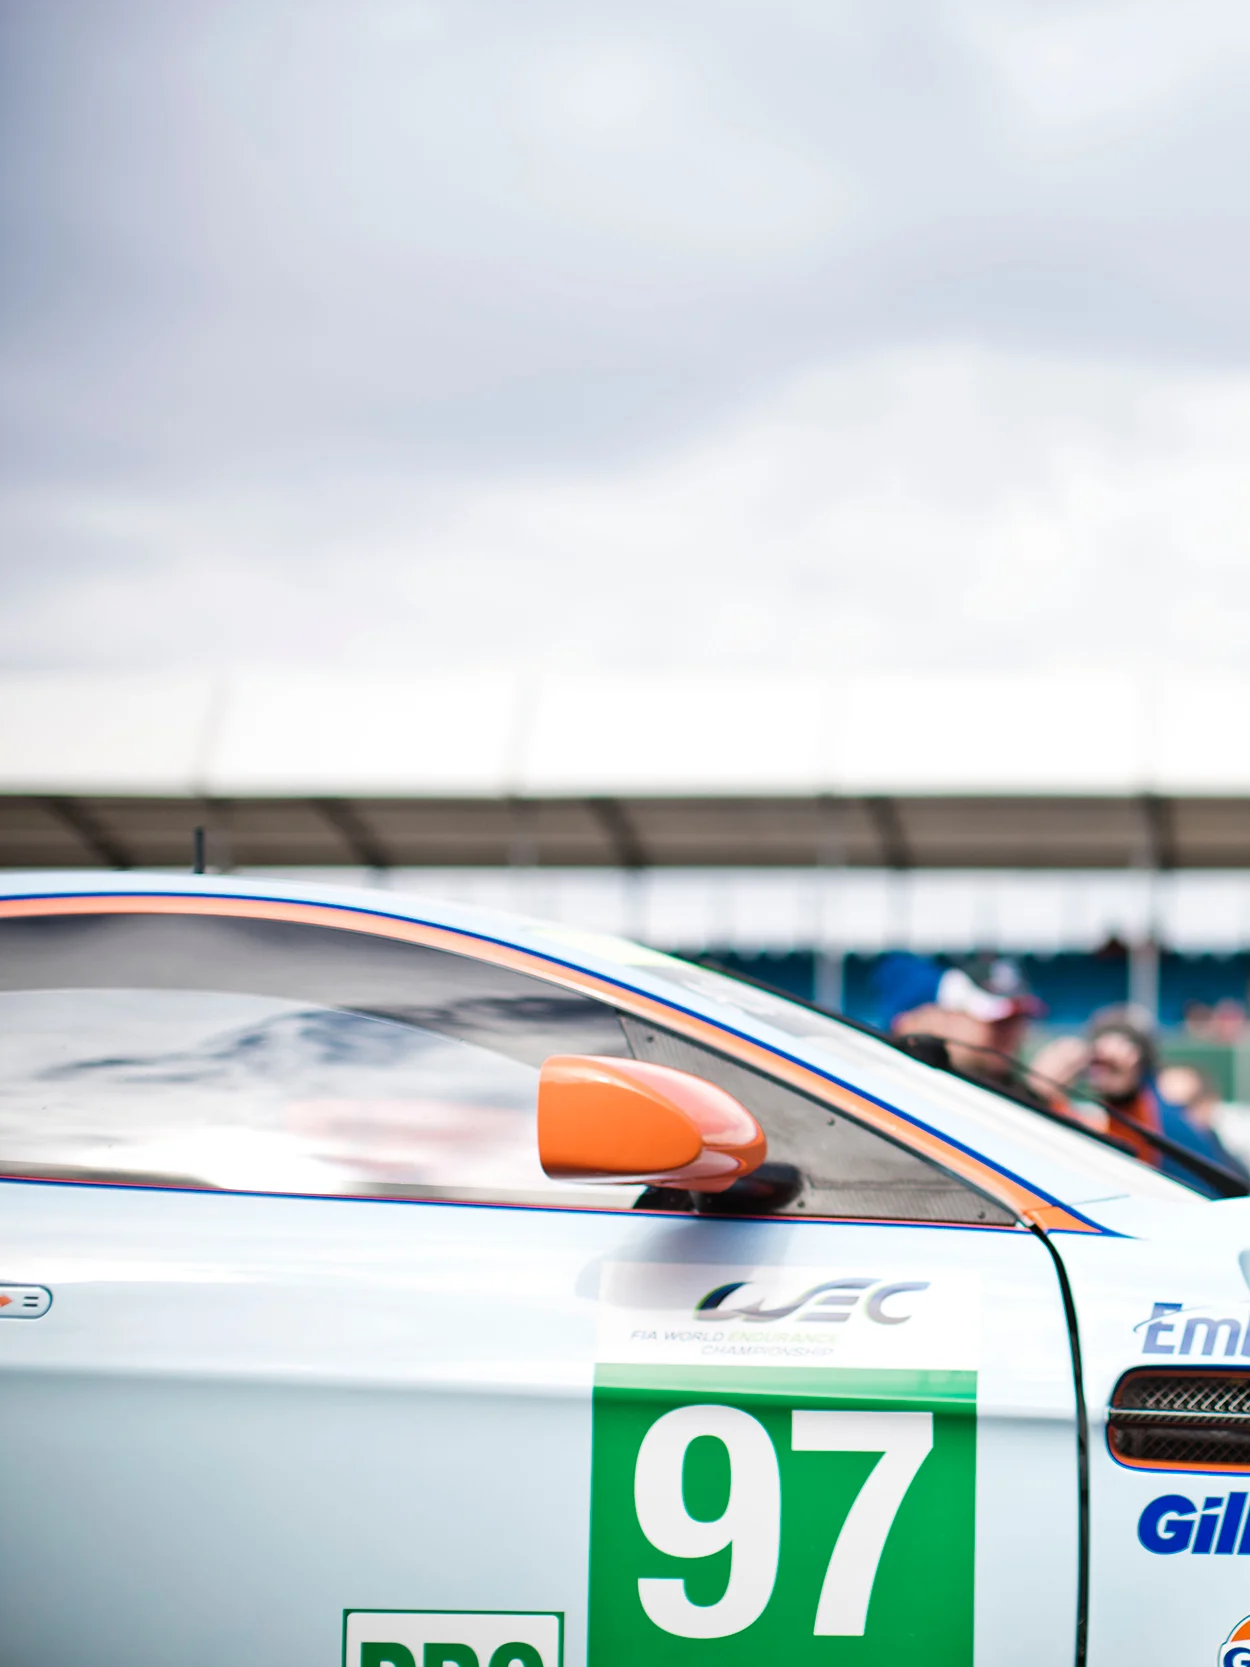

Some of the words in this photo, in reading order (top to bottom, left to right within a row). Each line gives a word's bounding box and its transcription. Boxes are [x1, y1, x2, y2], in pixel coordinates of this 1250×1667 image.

[692, 1277, 932, 1326] WEC
[630, 1330, 659, 1342] FIA
[664, 1330, 724, 1343] WORLD
[727, 1331, 838, 1345] ENDURANCE
[700, 1345, 835, 1358] CHAMPIONSHIP
[634, 1404, 934, 1639] 97
